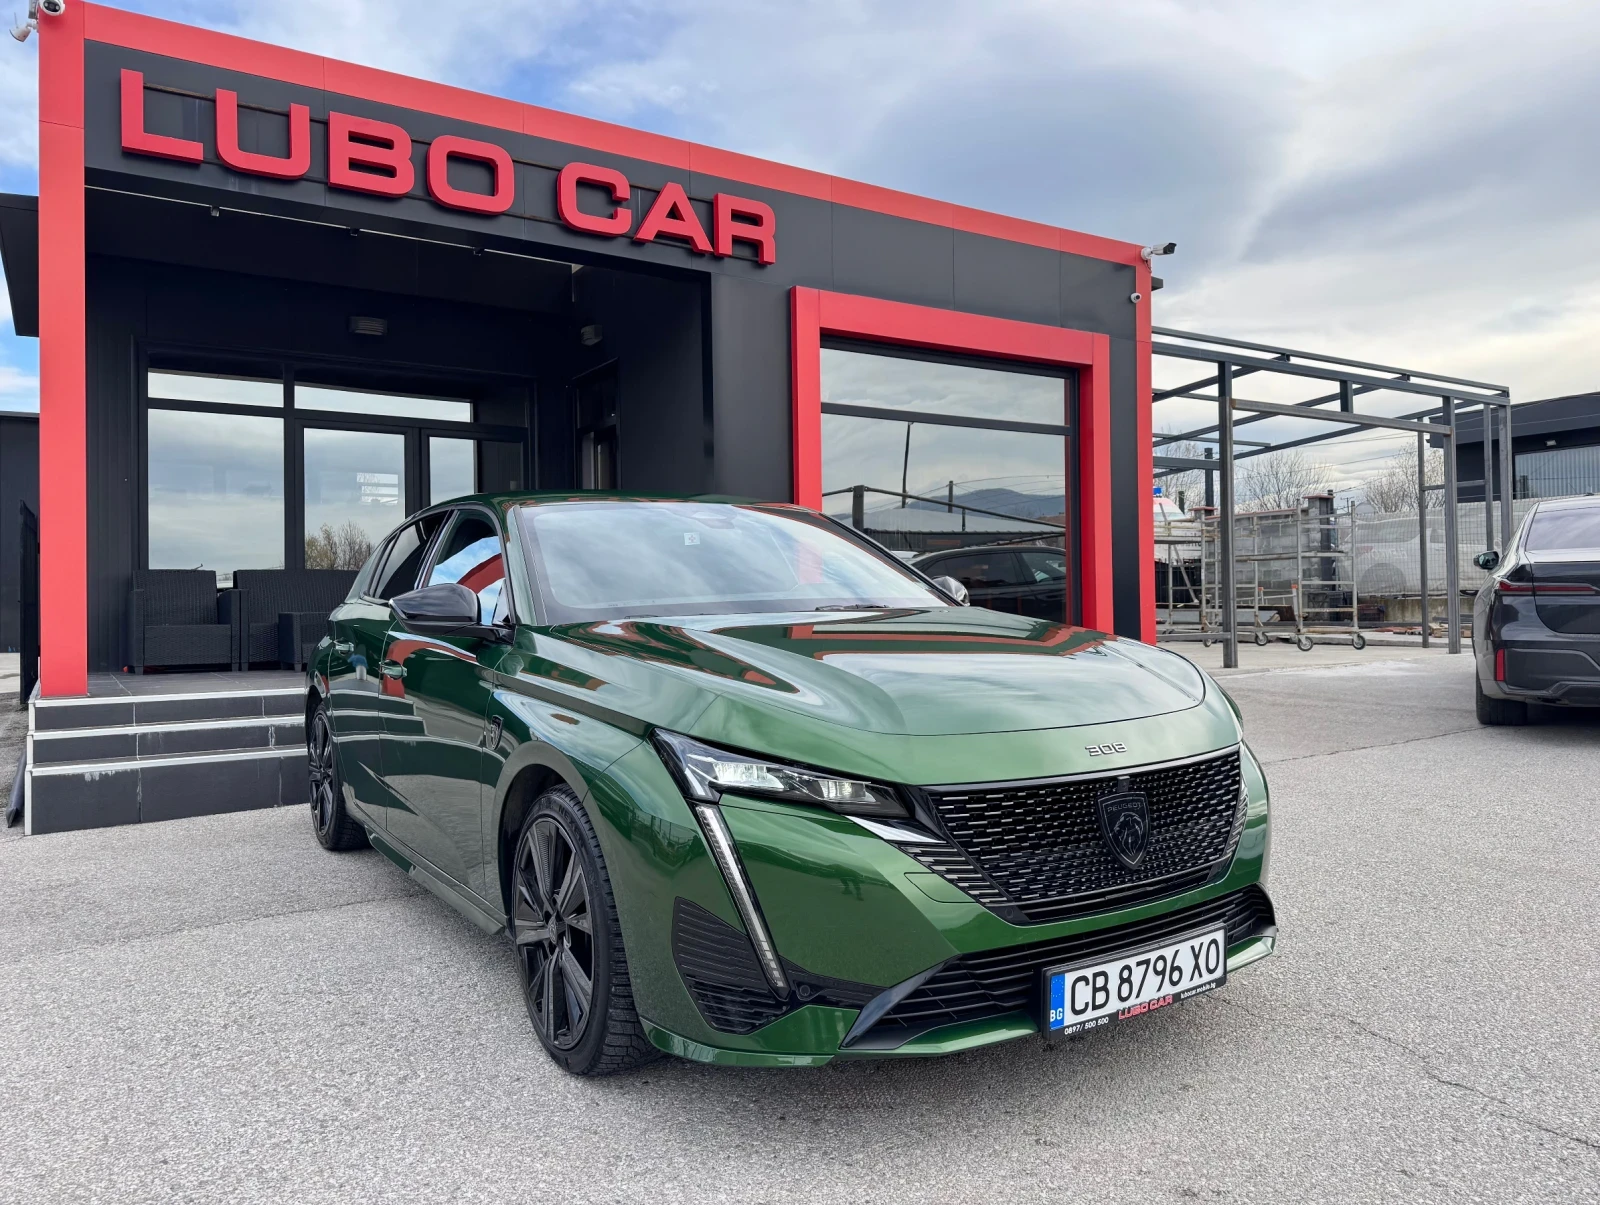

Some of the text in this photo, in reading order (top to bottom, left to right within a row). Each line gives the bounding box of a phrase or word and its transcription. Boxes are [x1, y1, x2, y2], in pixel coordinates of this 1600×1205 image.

[120, 67, 777, 266] LUBO CAR
[1085, 741, 1128, 757] 308
[1107, 802, 1142, 812] PEUGEOT
[1070, 938, 1220, 1016] CB 8796 XO
[1050, 1007, 1063, 1022] BG
[1118, 994, 1173, 1020] LUBO CAR
[1064, 1016, 1109, 1035] 0897/ 500 500
